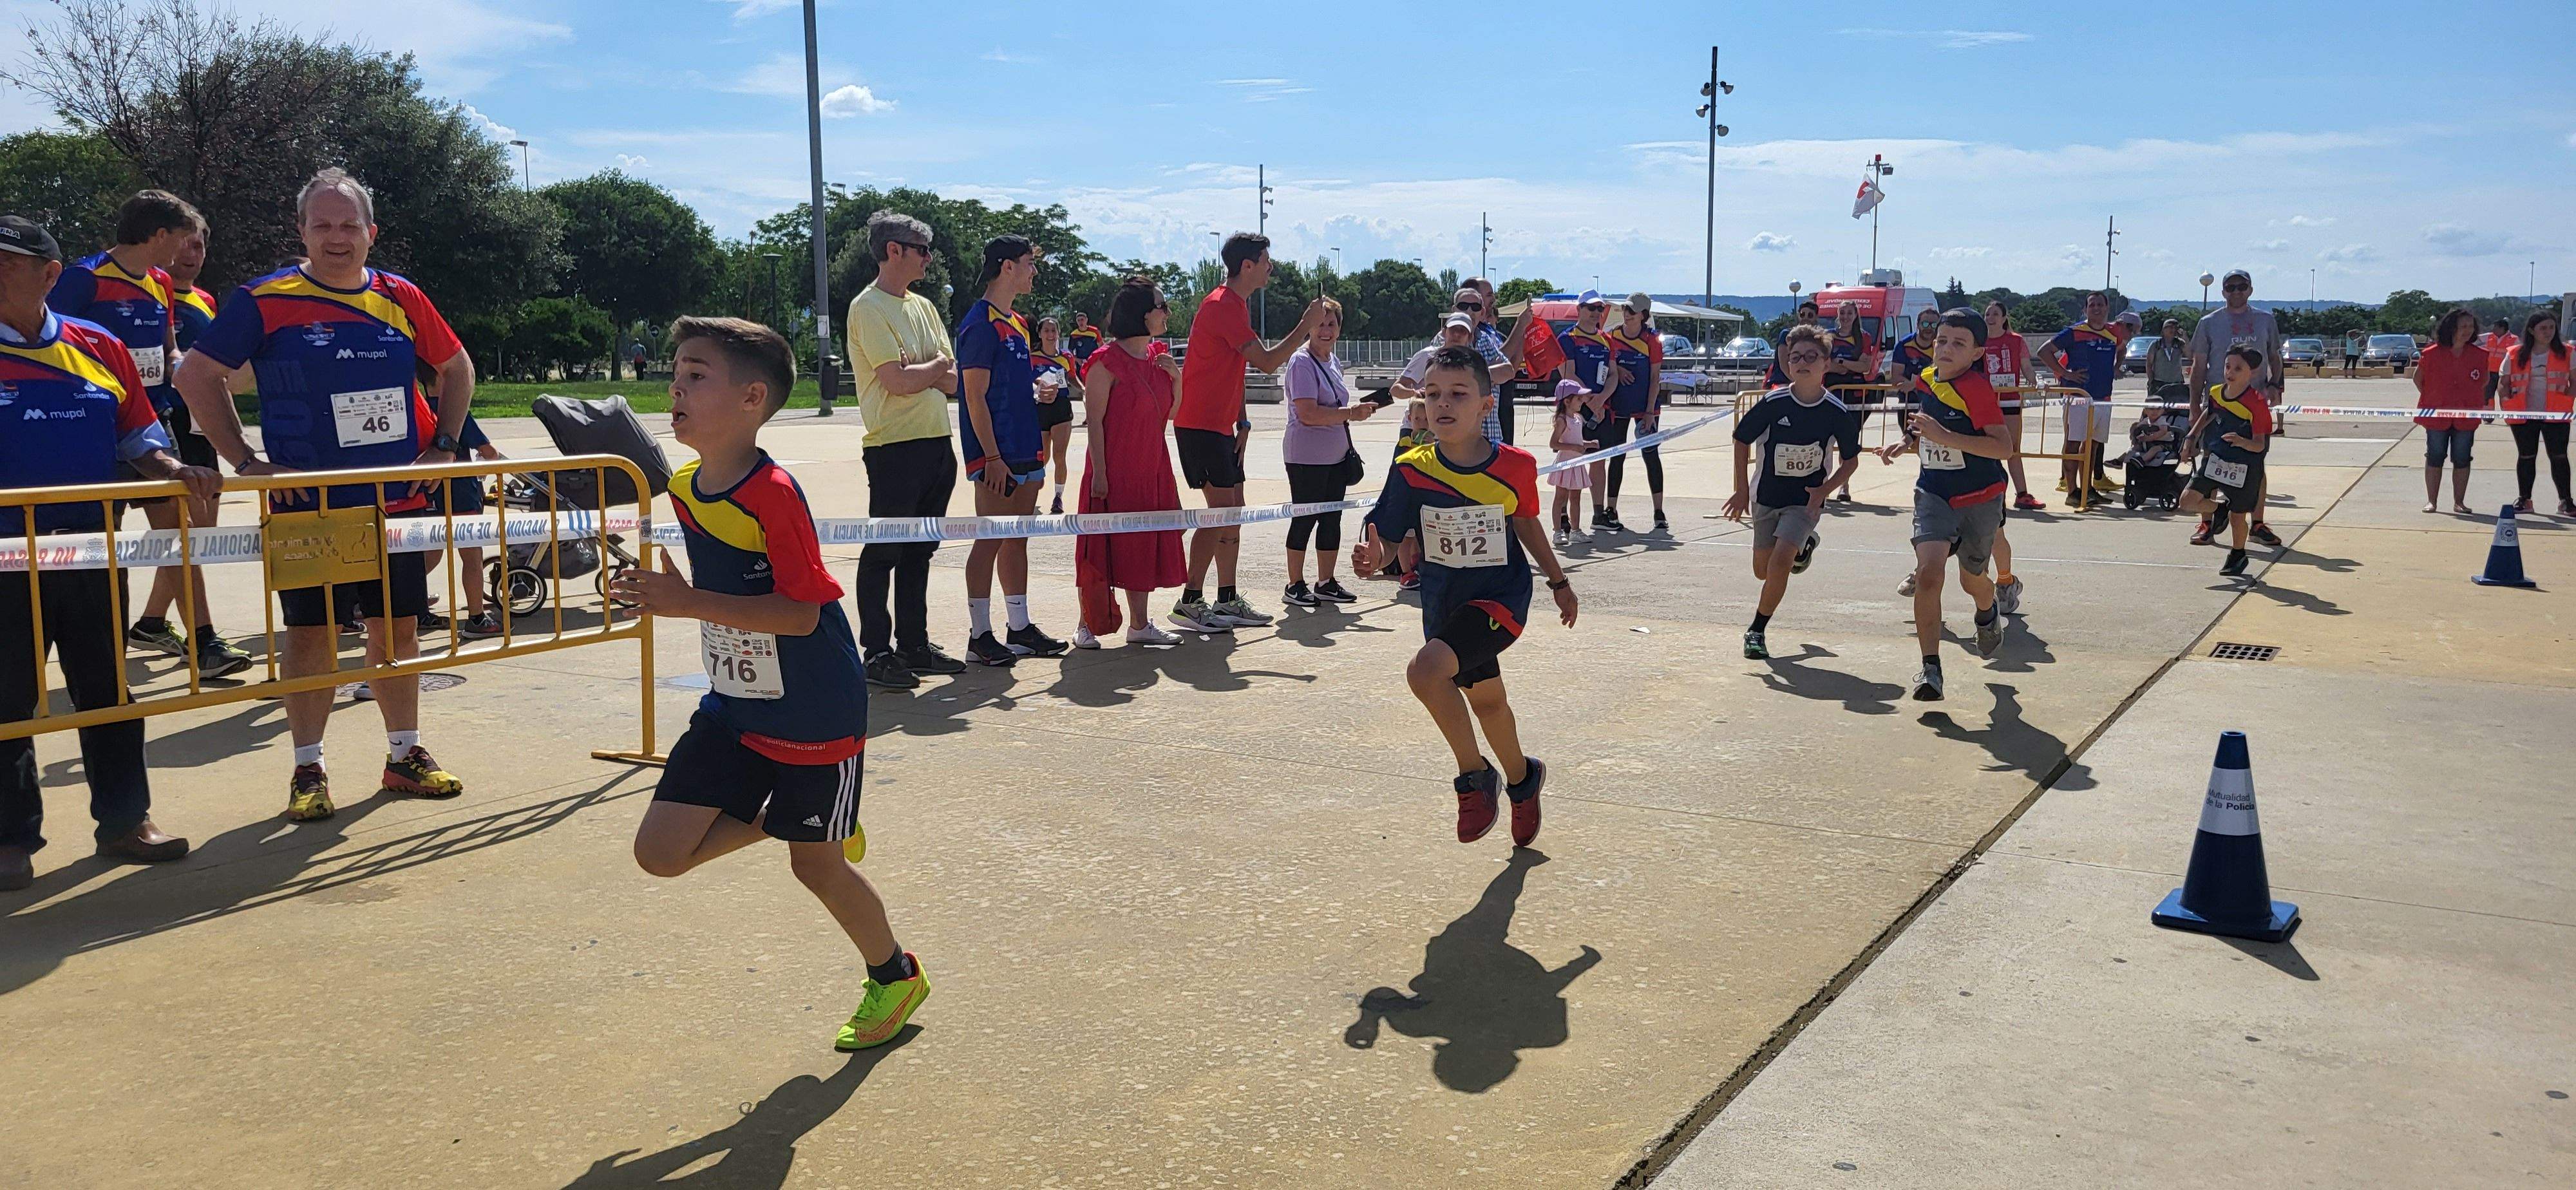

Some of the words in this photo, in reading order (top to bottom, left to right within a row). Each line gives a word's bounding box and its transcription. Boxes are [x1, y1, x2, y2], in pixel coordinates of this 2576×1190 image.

[357, 349, 388, 360] mupol
[138, 366, 160, 379] 468
[50, 407, 87, 419] mupol
[362, 415, 390, 433] 46
[1925, 449, 1951, 462] 712
[1786, 460, 1813, 471] 802
[2214, 468, 2237, 480] 816
[1439, 536, 1488, 556] 812
[708, 650, 757, 683] 716
[2208, 788, 2251, 802] Mutualidad
[2206, 797, 2213, 806] de
[2215, 800, 2222, 809] la
[2226, 802, 2255, 811] Policía
